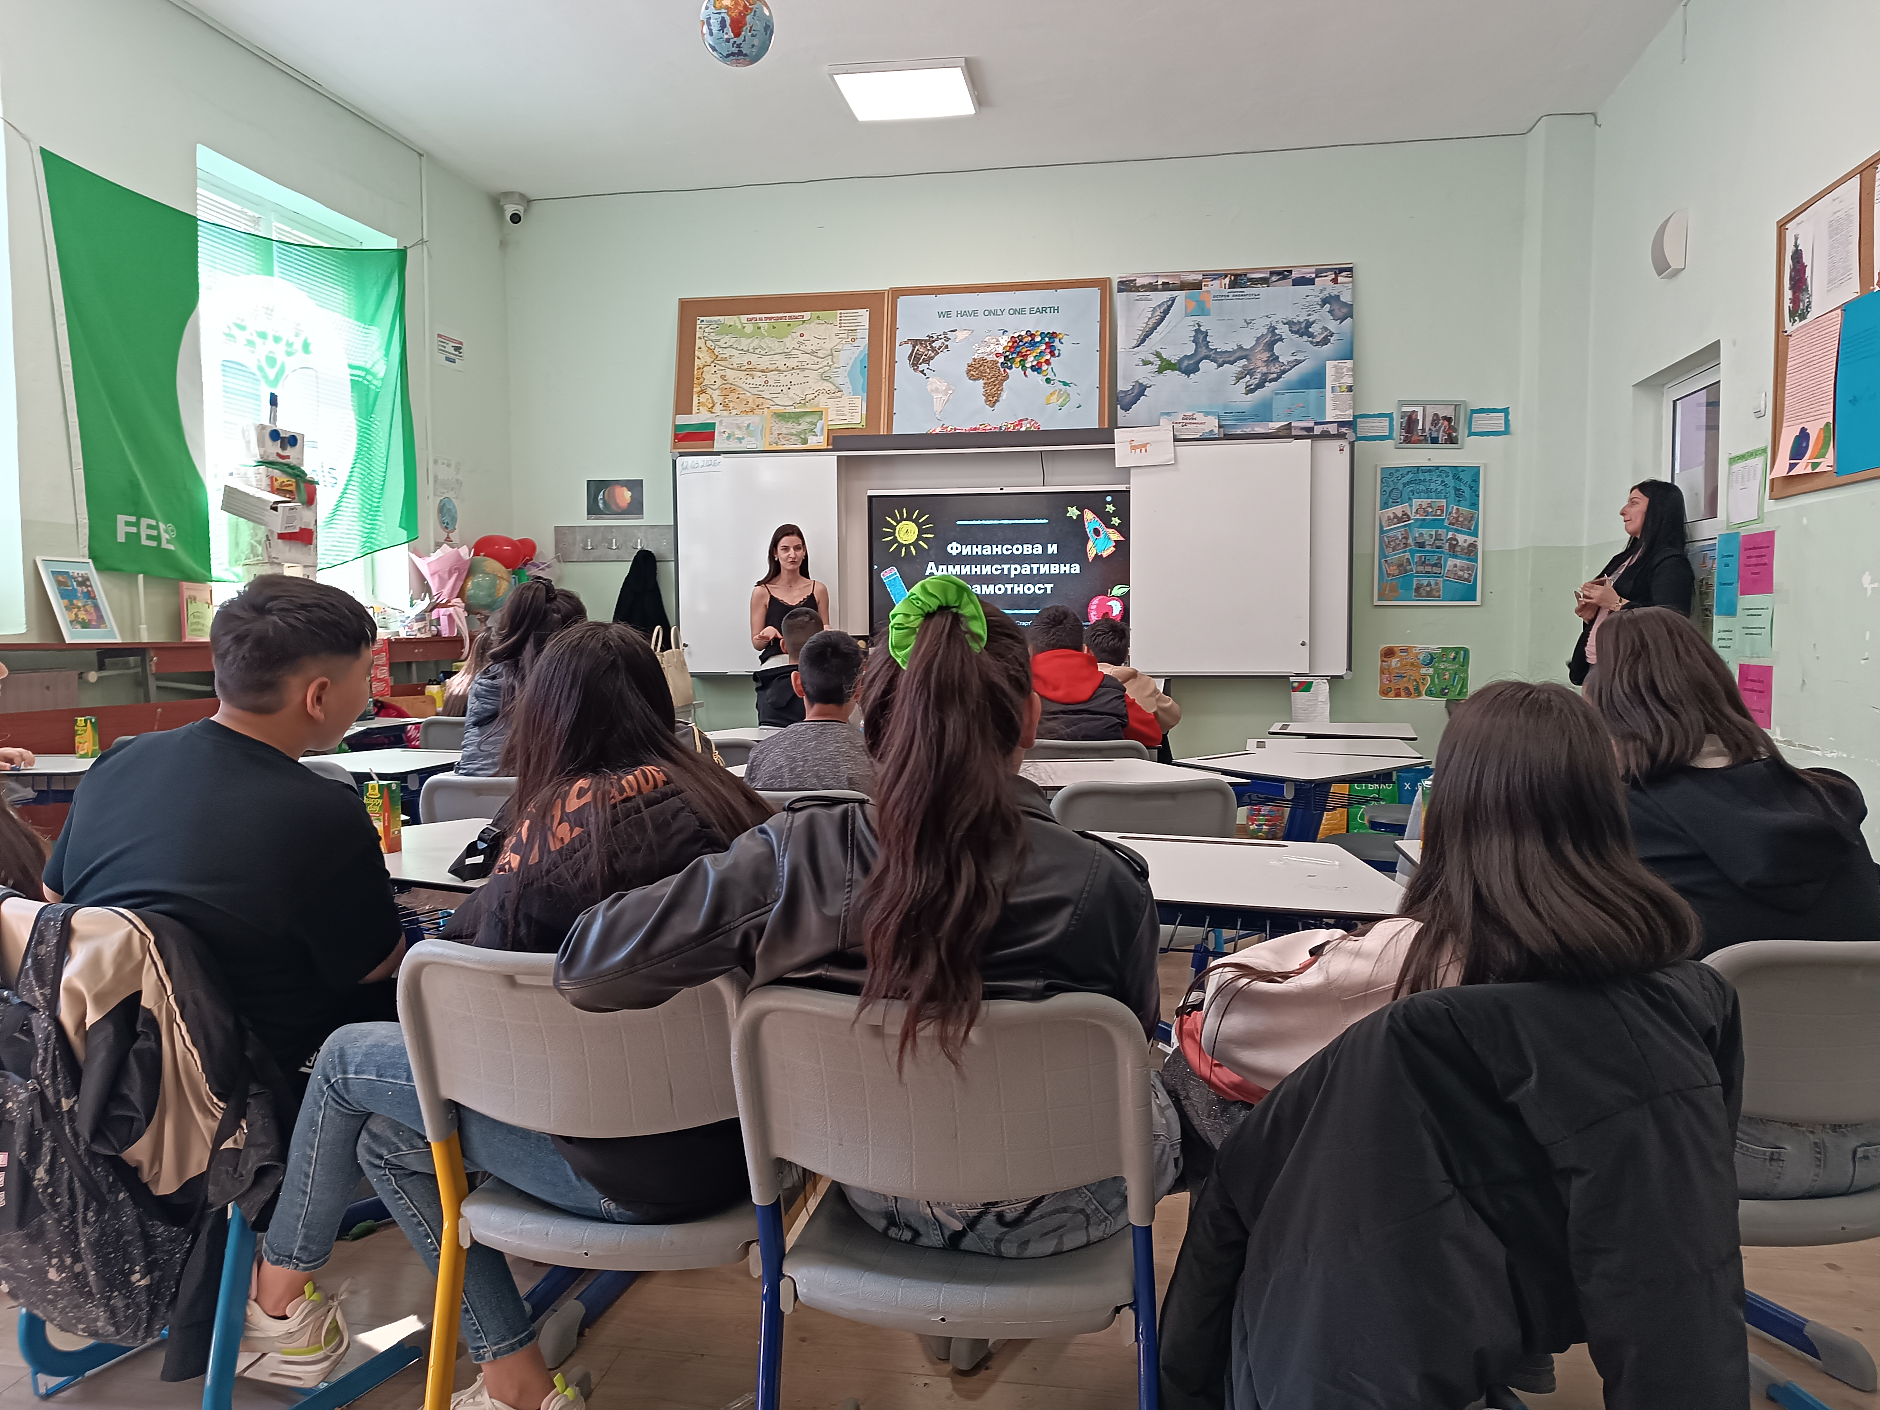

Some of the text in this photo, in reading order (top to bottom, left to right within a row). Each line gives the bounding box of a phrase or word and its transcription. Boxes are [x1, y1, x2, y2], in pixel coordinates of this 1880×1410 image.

[937, 305, 1060, 319] WE HAVE ONLY ONE EARTH
[116, 514, 175, 550] FEE
[946, 541, 1058, 555] Финансова и
[924, 561, 1081, 578] Административна
